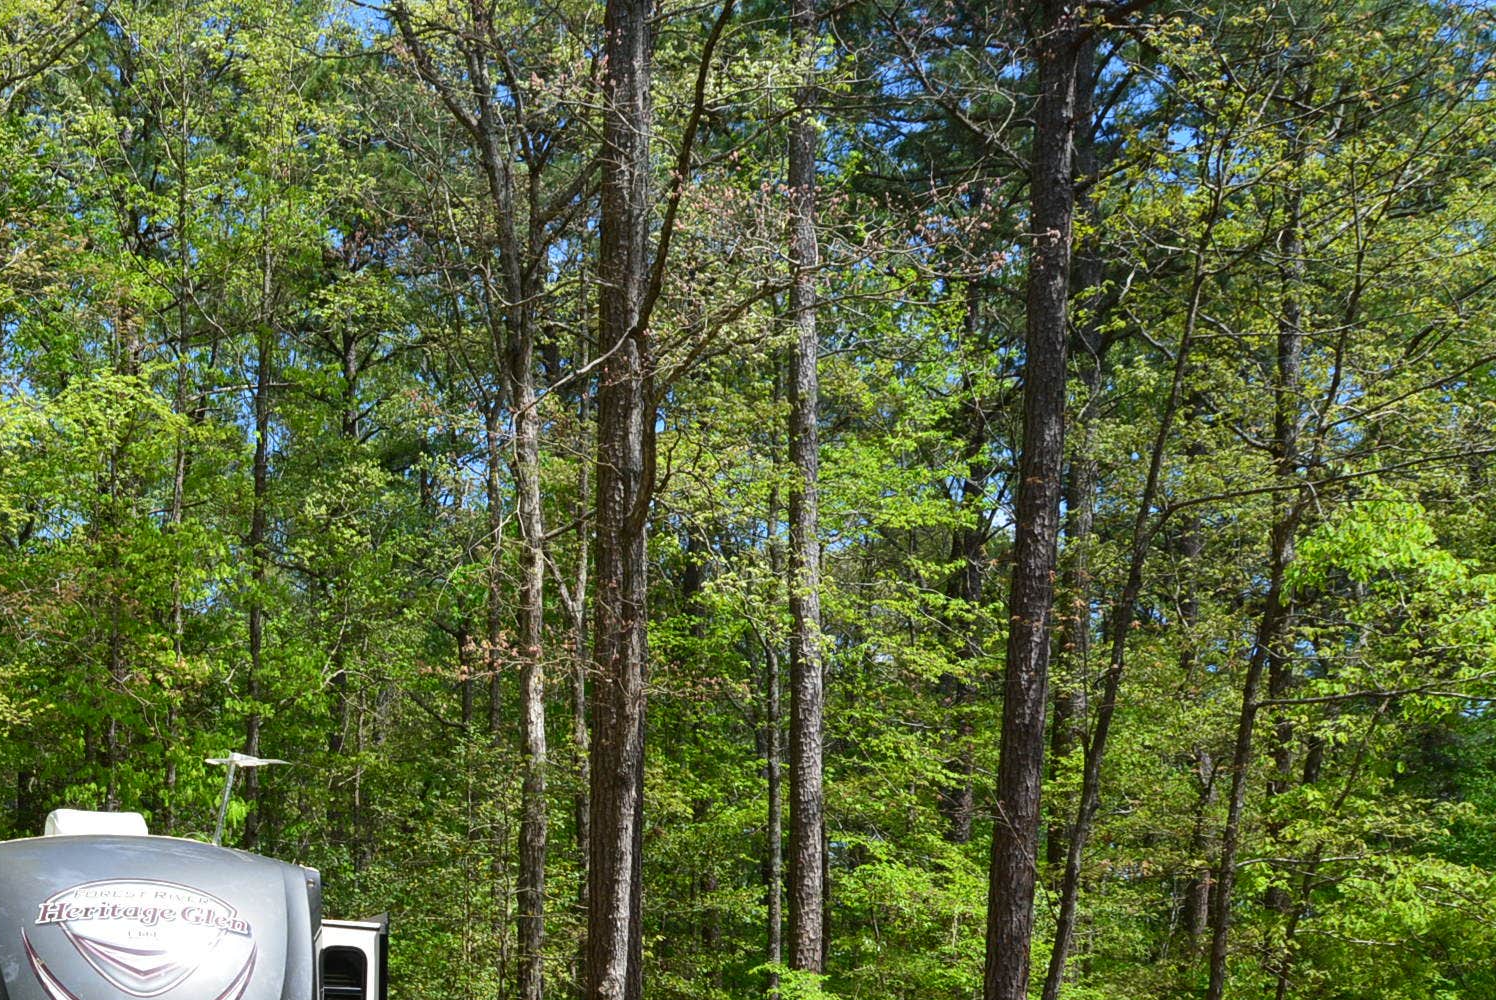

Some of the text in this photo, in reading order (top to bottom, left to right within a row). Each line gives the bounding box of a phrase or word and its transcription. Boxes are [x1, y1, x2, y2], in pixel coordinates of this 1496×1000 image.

[72, 888, 211, 905] FOREST RIVER
[36, 901, 249, 933] Heritage Glen
